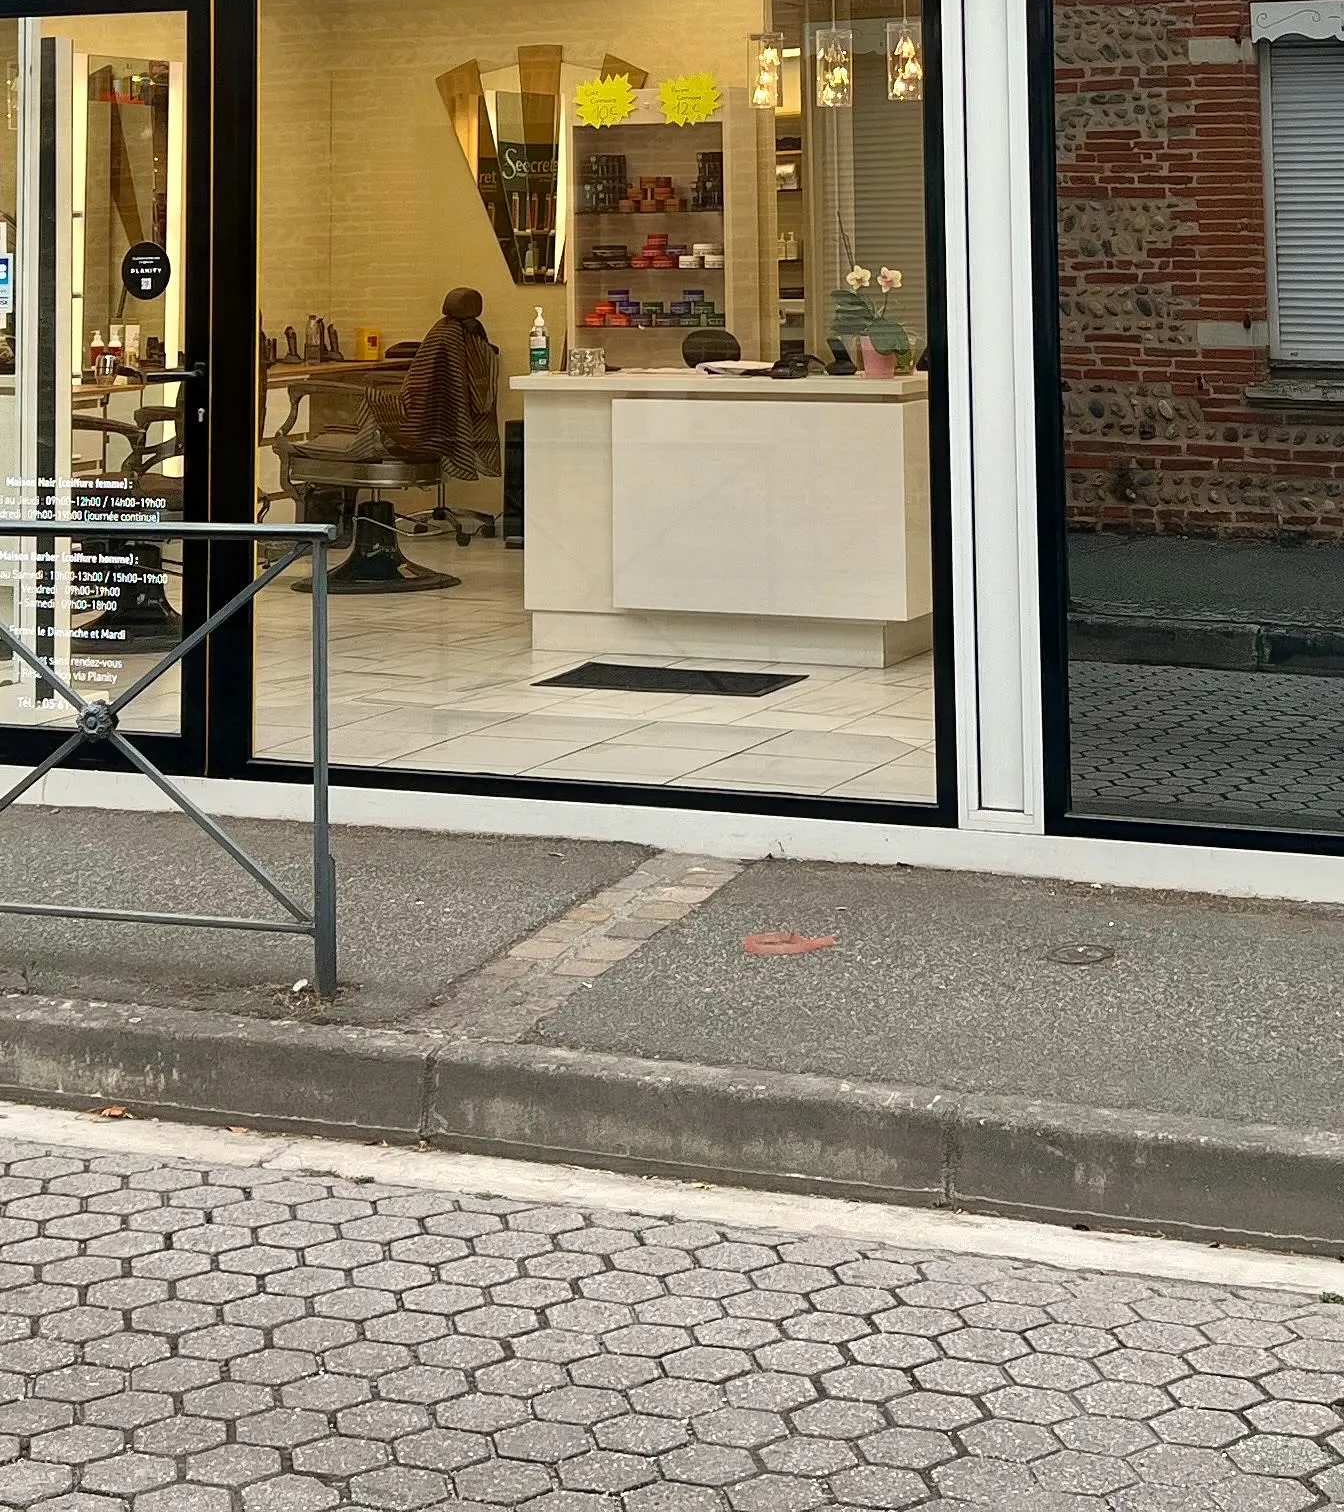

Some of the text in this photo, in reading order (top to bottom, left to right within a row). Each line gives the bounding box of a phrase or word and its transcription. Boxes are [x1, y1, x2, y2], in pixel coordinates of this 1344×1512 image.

[6, 477, 127, 489] Maison Hair (coiffure femme)
[5, 497, 16, 505] au
[45, 496, 101, 507] 09h00-12h00
[110, 497, 166, 508] 14h00-19h00
[30, 552, 59, 562] Barber
[61, 552, 97, 563] (coiffure
[99, 553, 134, 565] homme)
[38, 626, 45, 636] le
[47, 627, 89, 638] Dimanche
[90, 629, 100, 639] et
[101, 629, 126, 640] Mardi
[71, 657, 123, 668] rendez-vous
[73, 672, 86, 681] via
[87, 672, 118, 684] Planity
